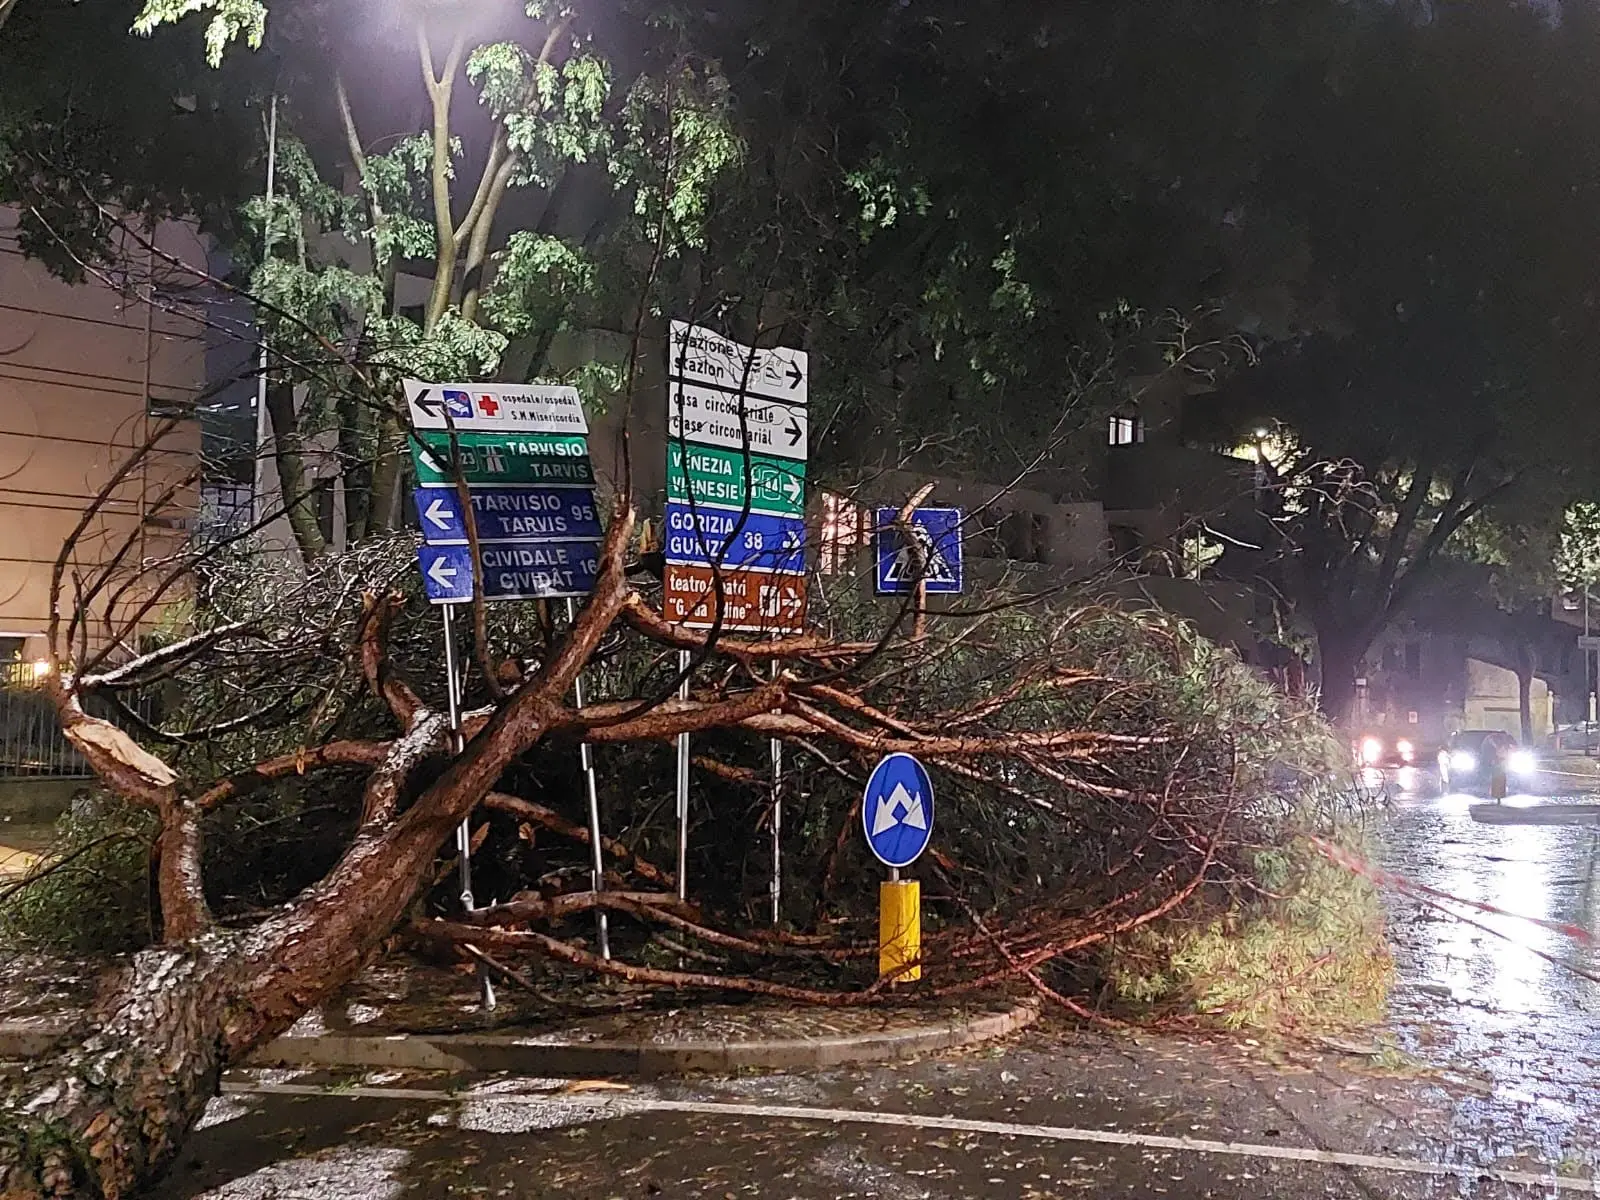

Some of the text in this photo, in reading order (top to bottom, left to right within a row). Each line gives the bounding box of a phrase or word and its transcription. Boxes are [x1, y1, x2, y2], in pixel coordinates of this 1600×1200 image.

[674, 332, 735, 356] sazione
[673, 417, 702, 432] case
[506, 442, 583, 456] TARVISIO
[472, 495, 561, 511] TARVISIO
[571, 505, 593, 521] 95
[670, 512, 735, 535] GORIZIA
[744, 531, 764, 550] 38
[482, 549, 569, 567] CIVIDALE
[580, 559, 597, 575] 16
